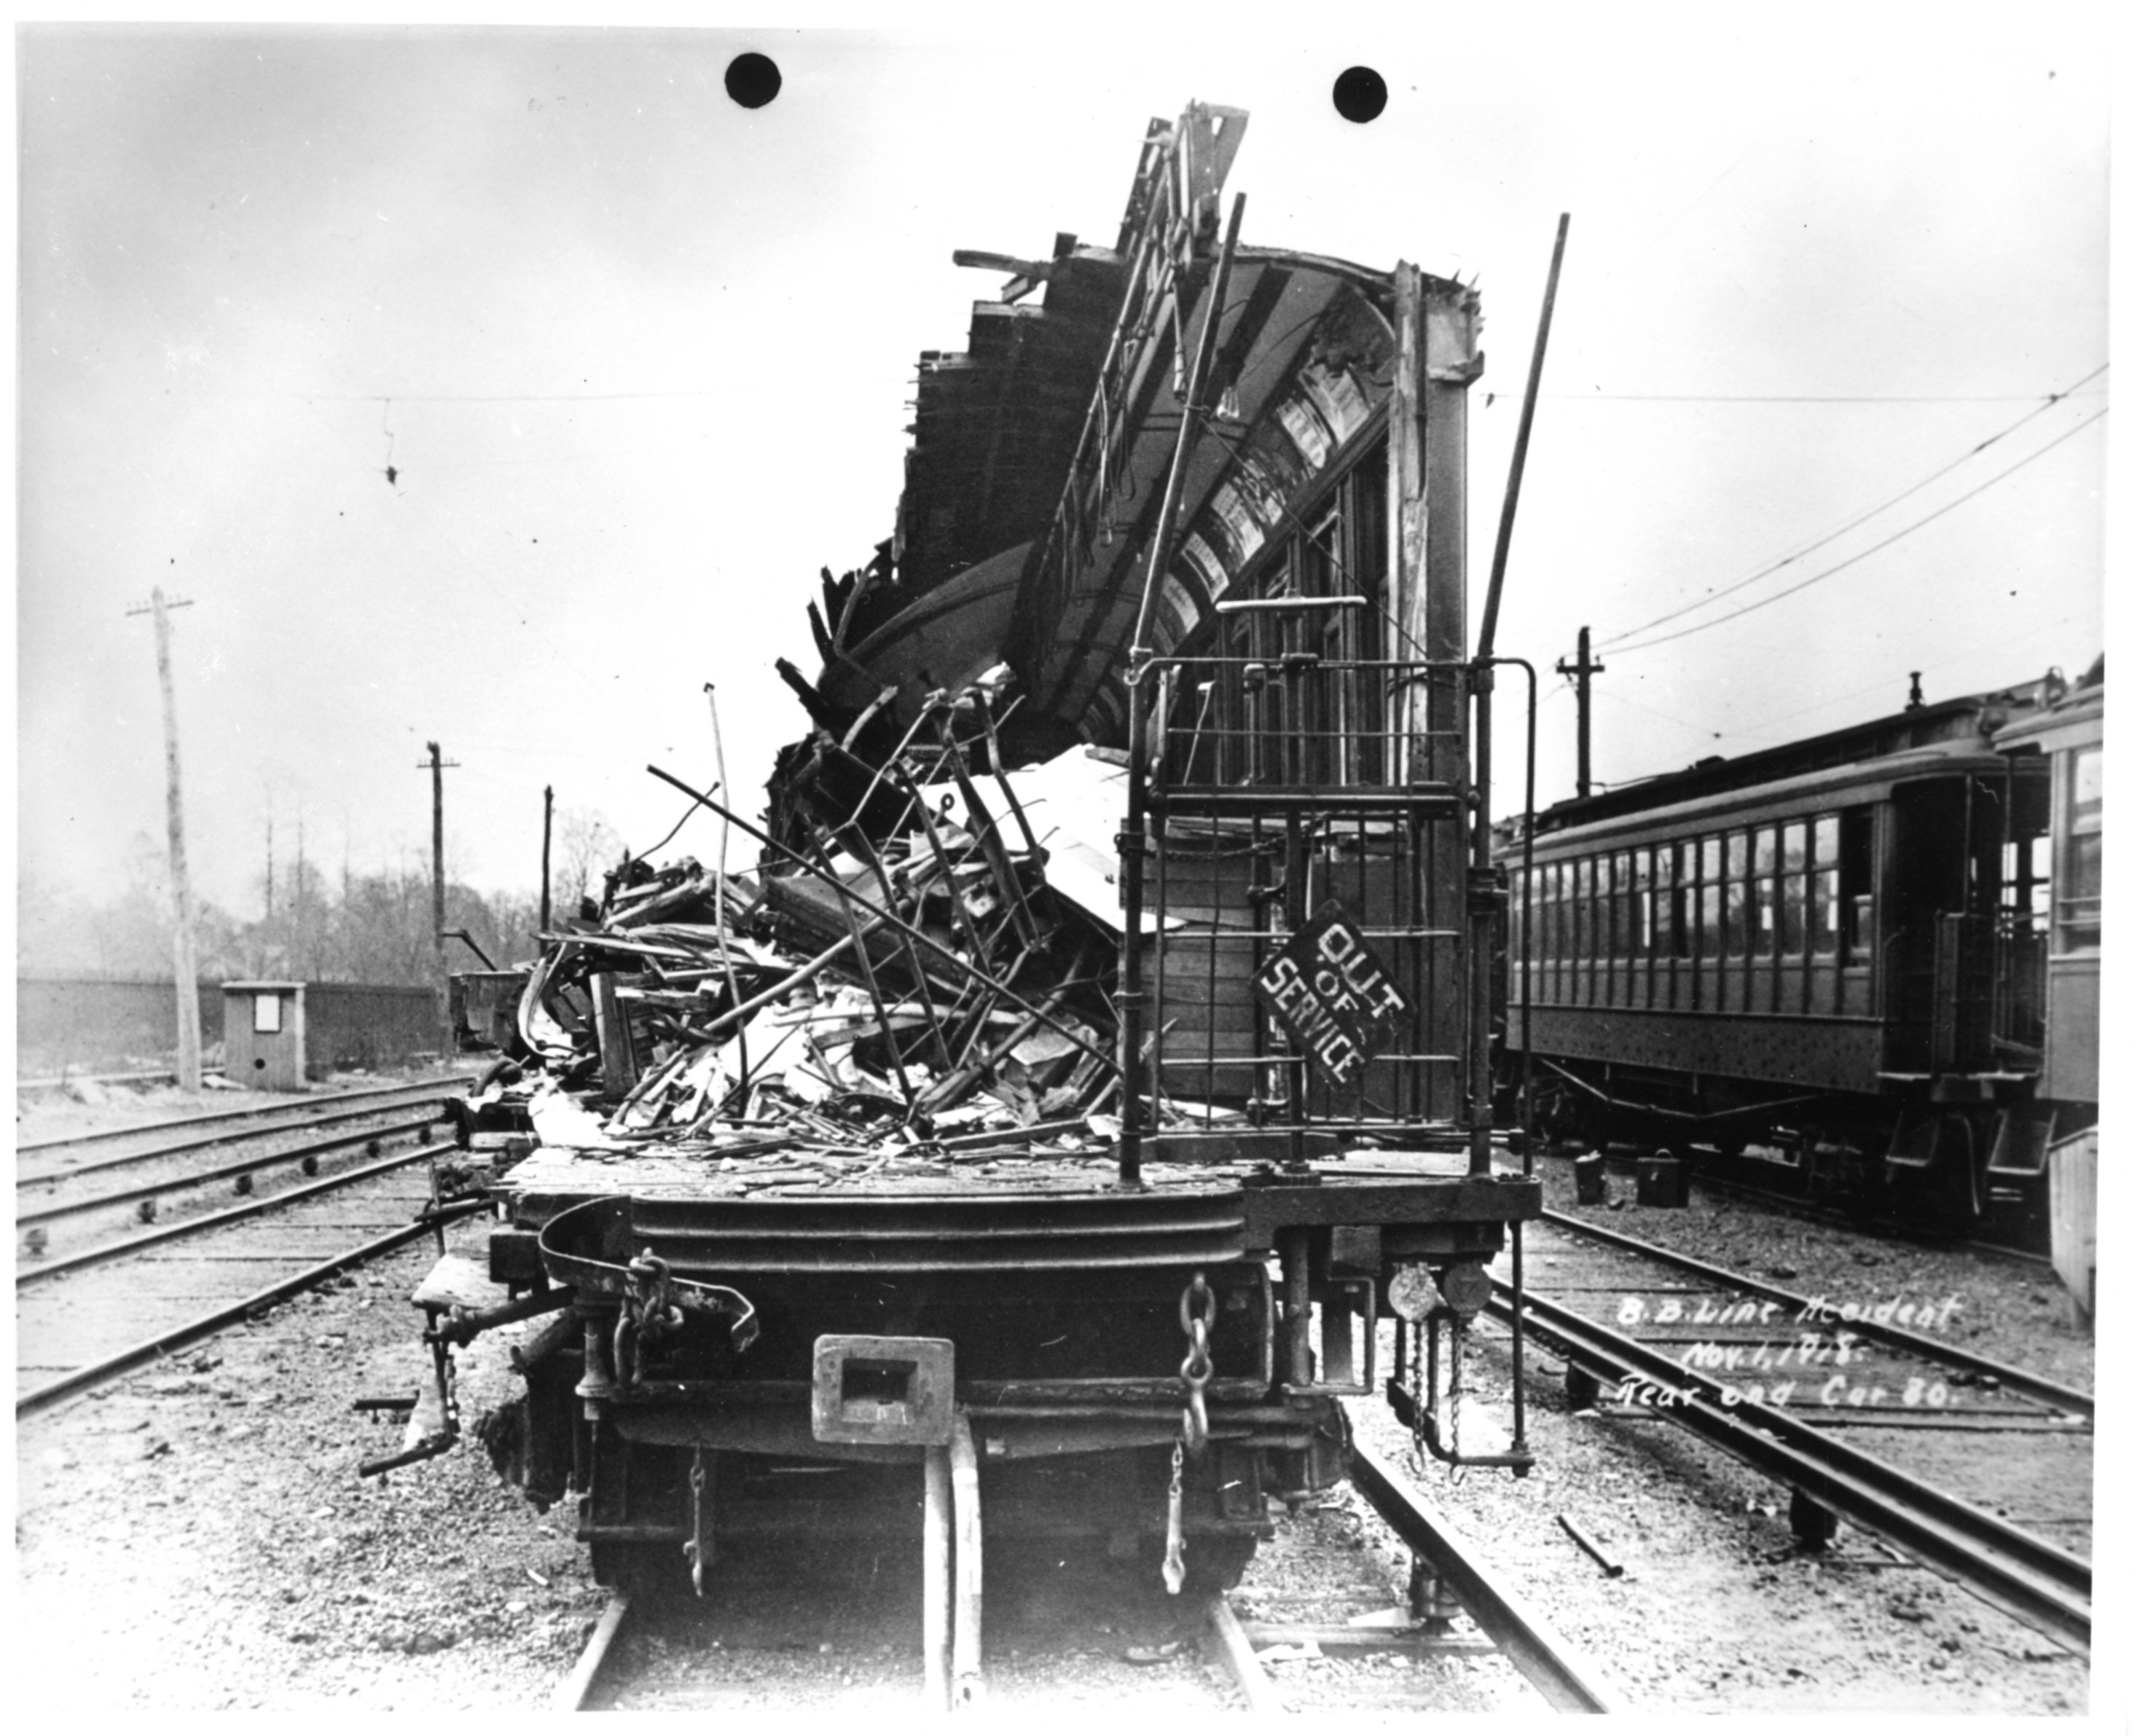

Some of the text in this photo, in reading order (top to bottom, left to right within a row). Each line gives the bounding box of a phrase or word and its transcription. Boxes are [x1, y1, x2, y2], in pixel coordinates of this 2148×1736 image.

[1314, 970, 1360, 1012] OF
[1318, 922, 1406, 1018] OUT
[1260, 957, 1366, 1084] SERVICE
